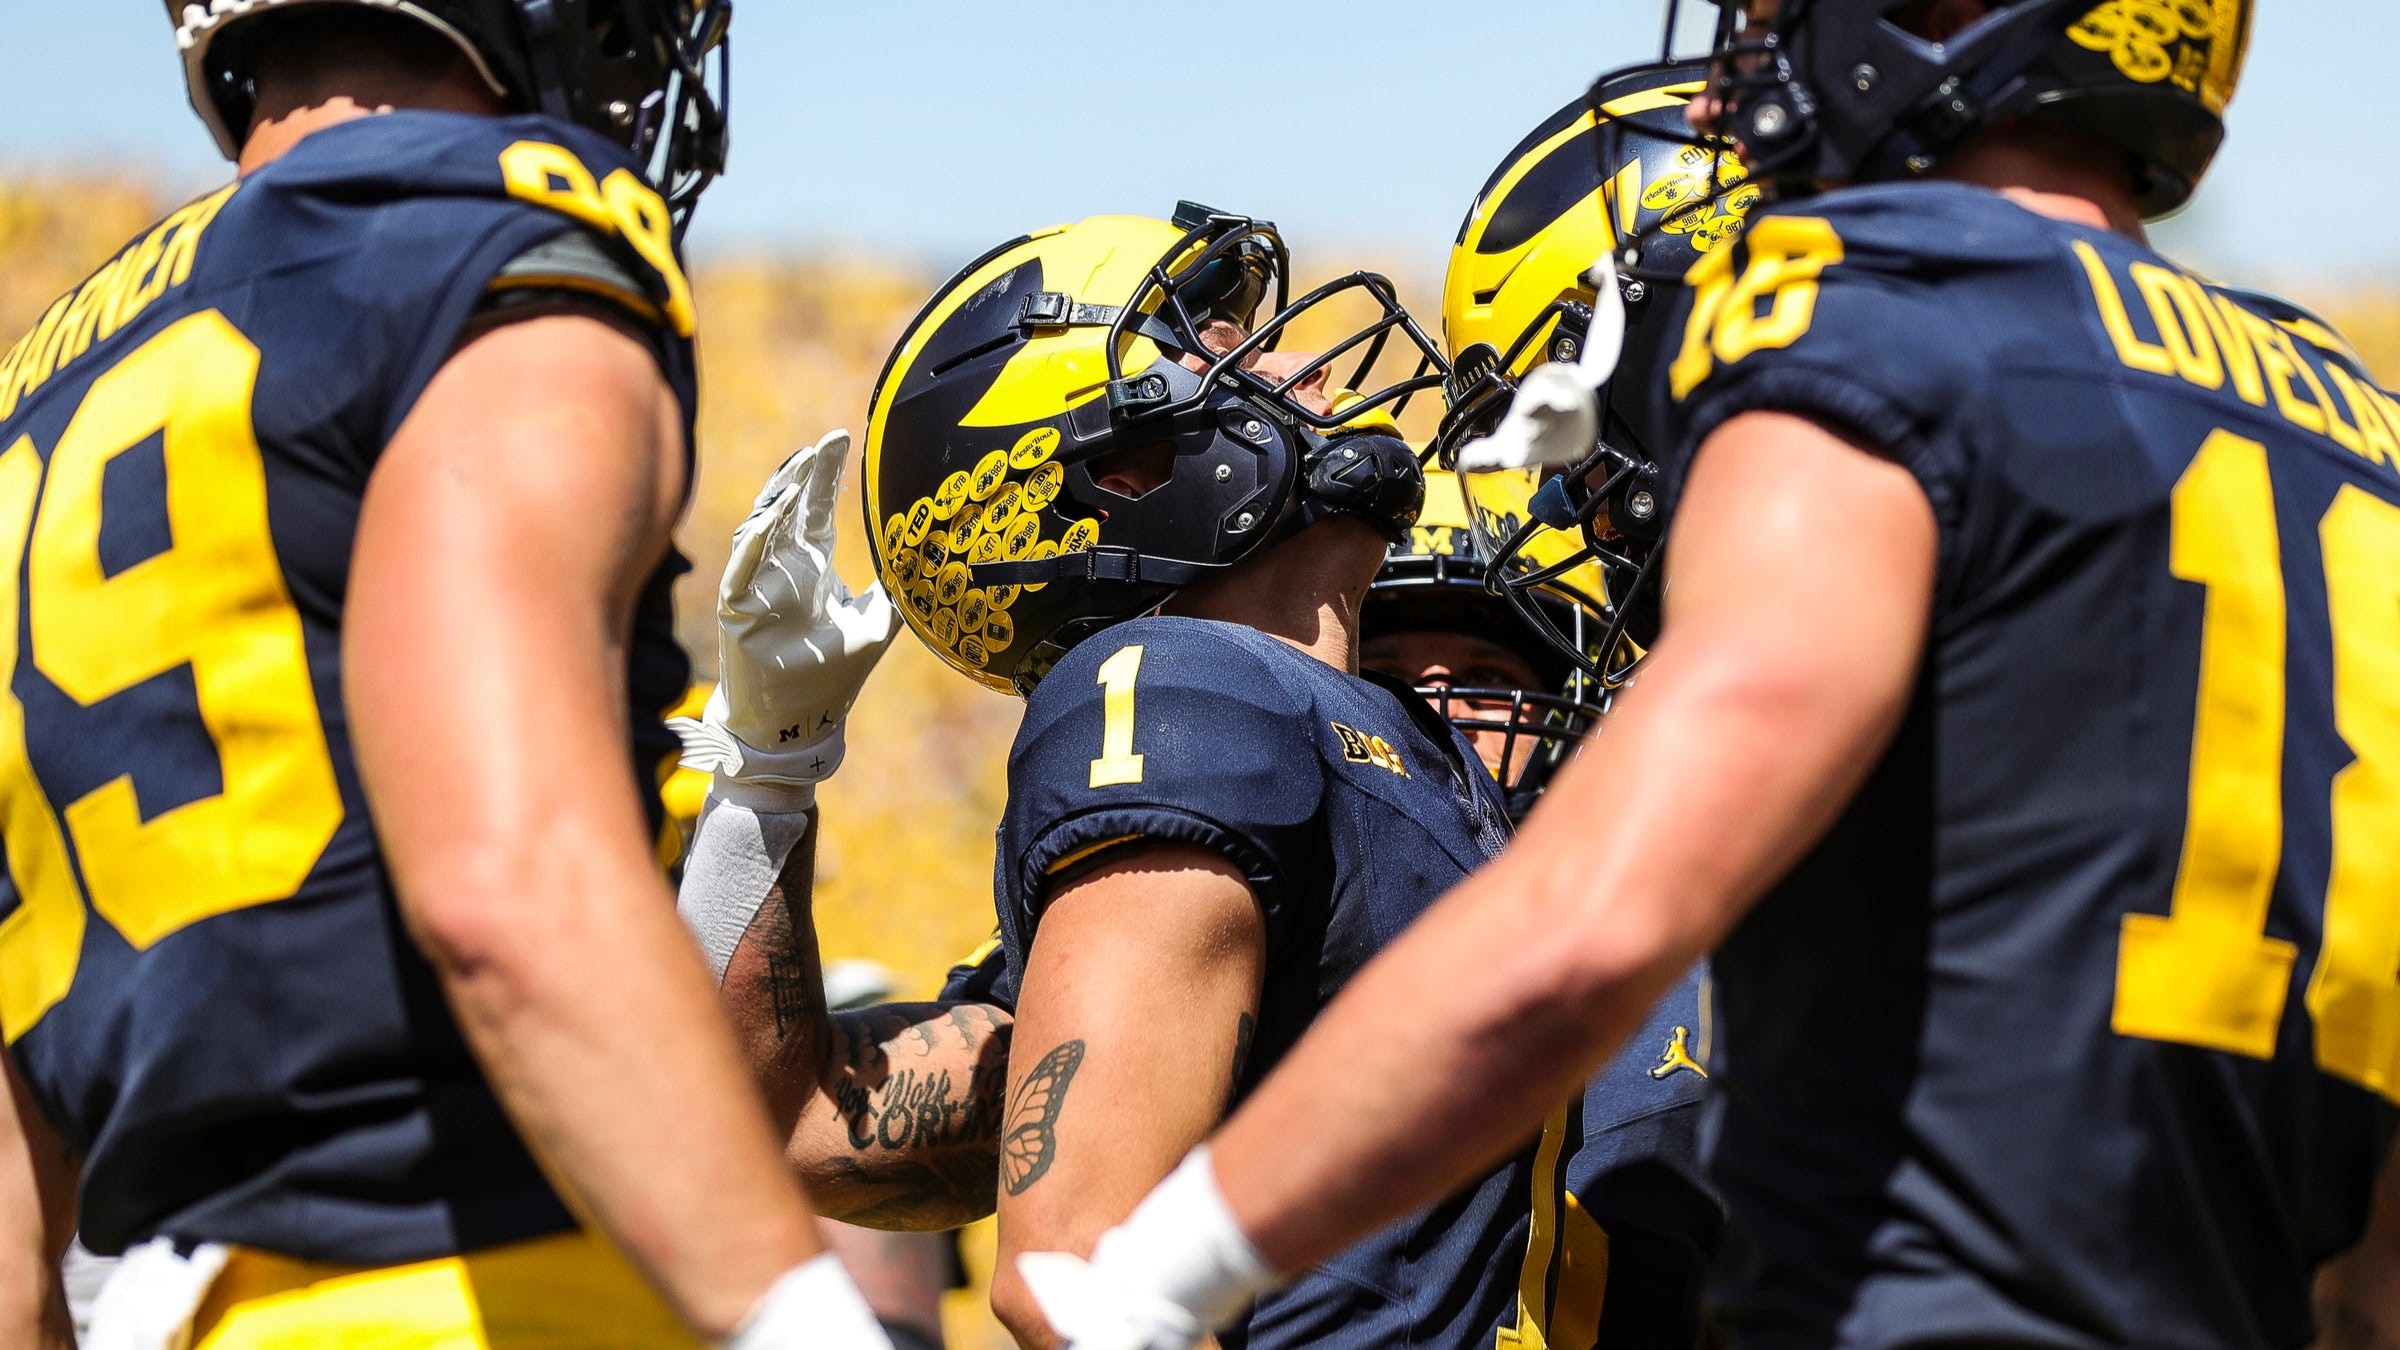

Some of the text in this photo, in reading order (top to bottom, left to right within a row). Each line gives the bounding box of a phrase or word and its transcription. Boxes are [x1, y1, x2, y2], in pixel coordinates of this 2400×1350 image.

[1667, 214, 1844, 401] 18
[2071, 239, 2400, 478] LOVELA
[1012, 428, 1054, 463] Fiesta Bowl
[952, 476, 967, 493] 978
[990, 458, 1006, 478] 982
[908, 503, 930, 539] TED
[1411, 526, 1455, 555] M
[779, 724, 801, 743] M
[1089, 645, 1144, 789] 1
